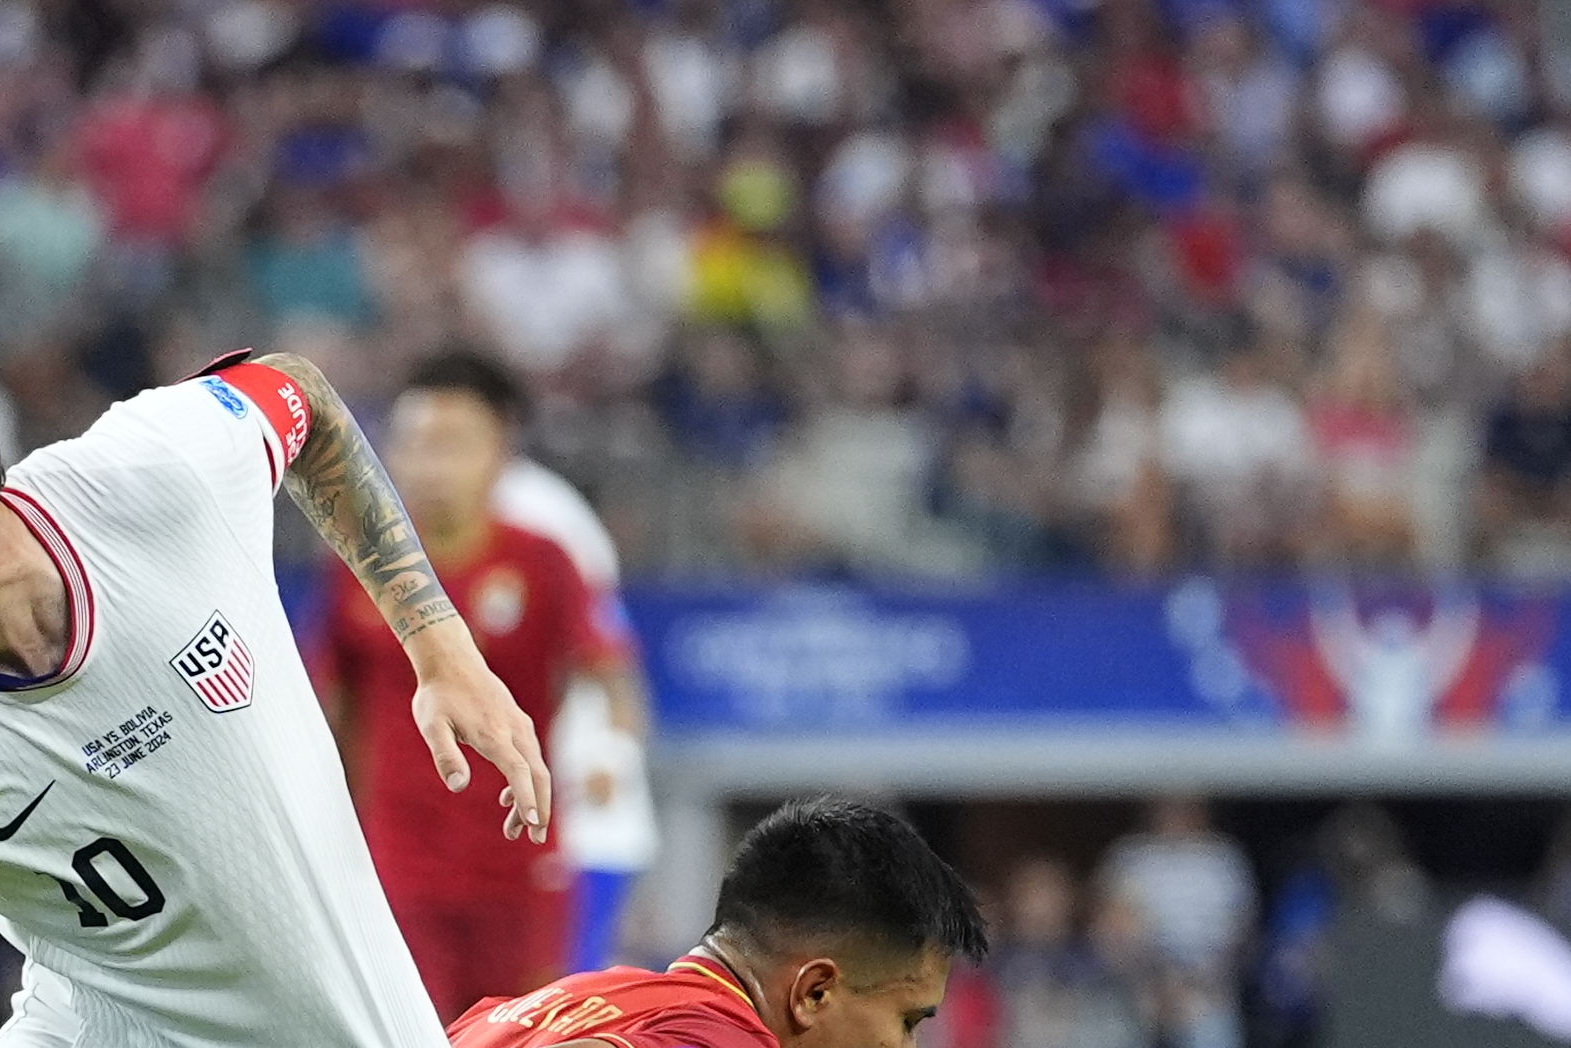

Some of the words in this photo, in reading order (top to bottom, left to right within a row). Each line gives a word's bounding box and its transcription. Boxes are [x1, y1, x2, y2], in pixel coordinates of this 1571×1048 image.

[178, 620, 230, 677] USA
[82, 739, 105, 757] USA
[119, 706, 157, 736] BOLIVIA
[139, 711, 173, 738] TEXAS
[105, 763, 121, 779] 23
[121, 746, 147, 769] JUNE
[144, 731, 171, 753] 2024
[33, 837, 165, 927] 10
